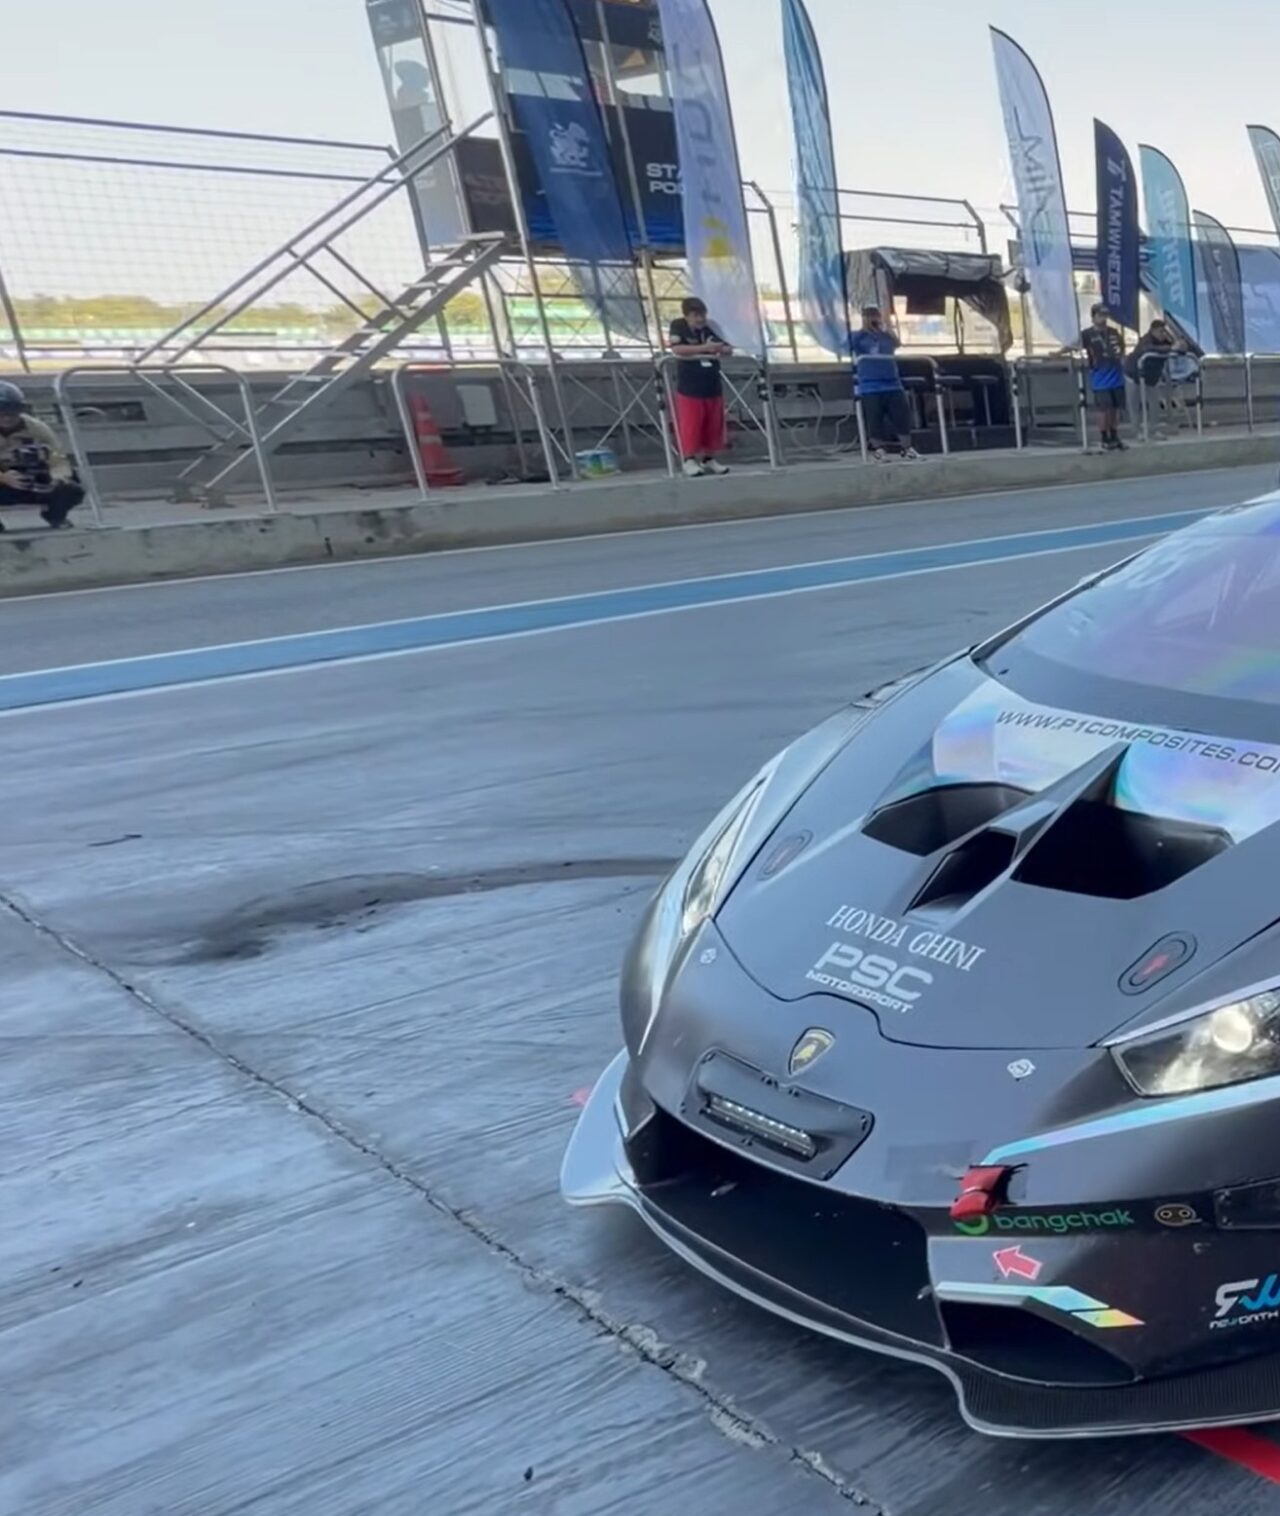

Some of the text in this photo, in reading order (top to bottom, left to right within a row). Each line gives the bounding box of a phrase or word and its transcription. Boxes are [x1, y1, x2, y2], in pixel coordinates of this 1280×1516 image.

[1107, 184, 1125, 306] TAMWHEELS
[826, 904, 986, 972] HONDA GHINI
[805, 969, 914, 1013] MOTORSPORT
[813, 941, 934, 1001] PSC
[993, 1209, 1135, 1232] bangchak
